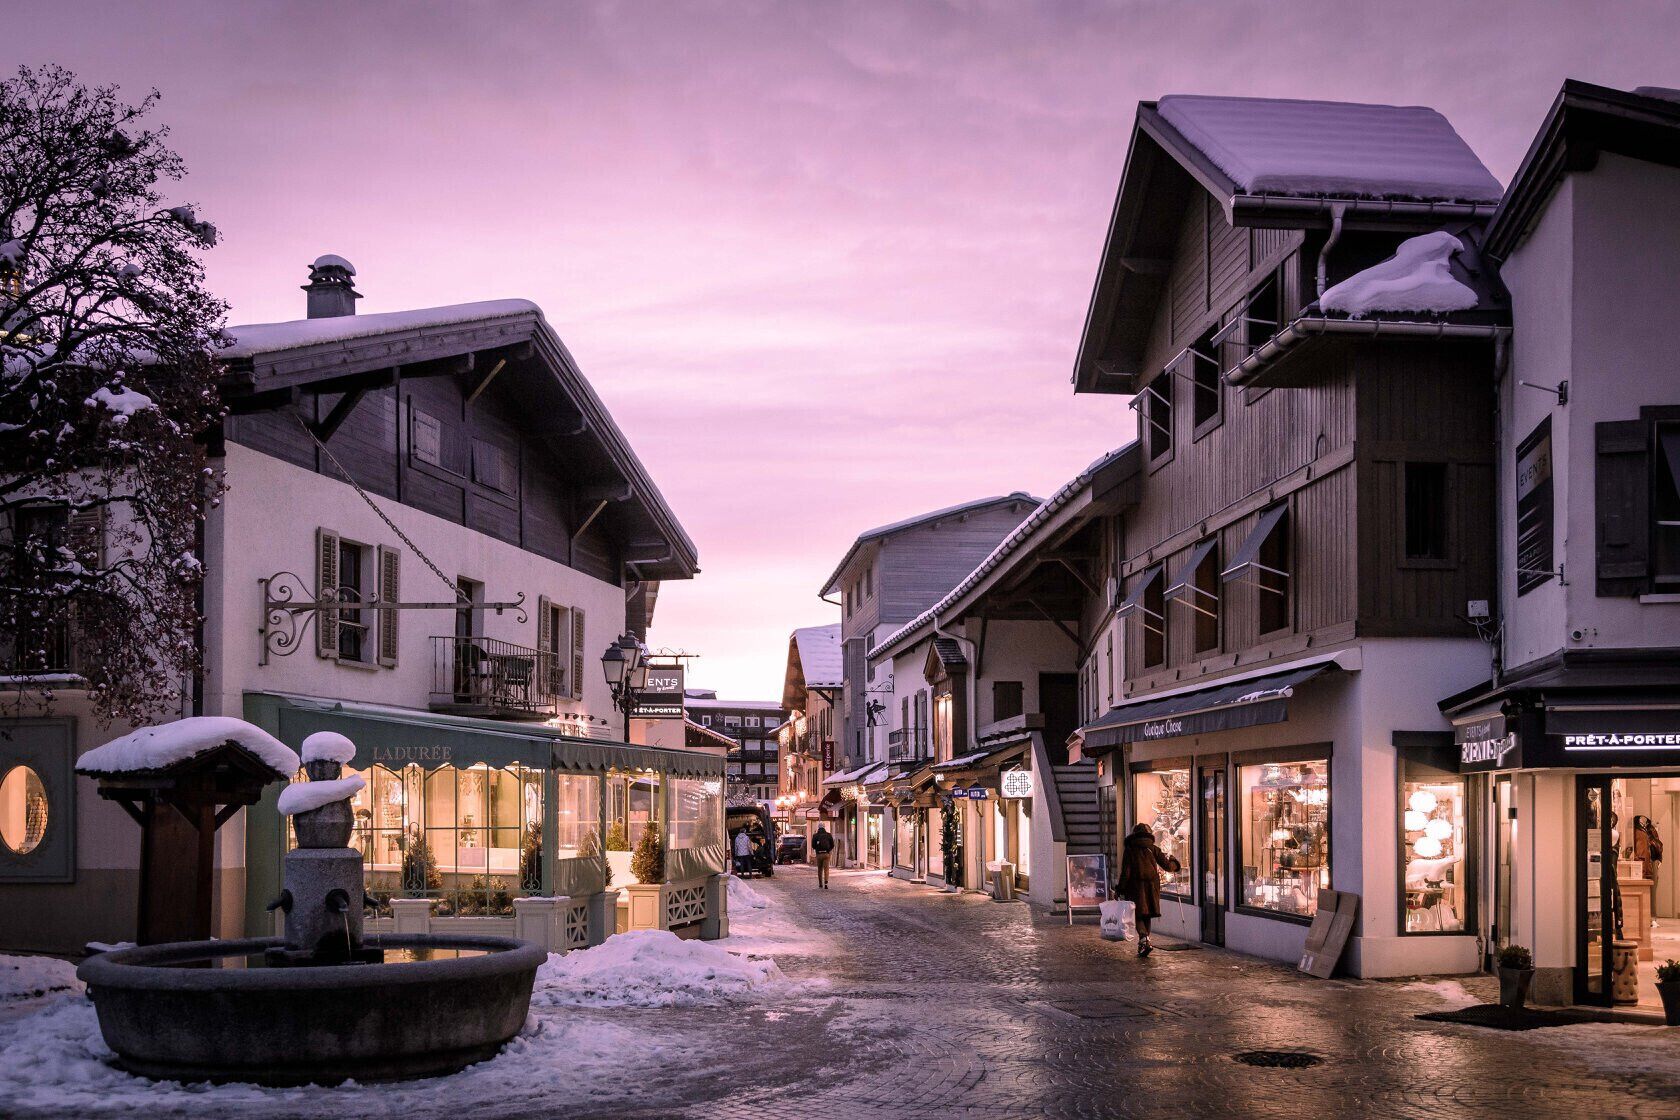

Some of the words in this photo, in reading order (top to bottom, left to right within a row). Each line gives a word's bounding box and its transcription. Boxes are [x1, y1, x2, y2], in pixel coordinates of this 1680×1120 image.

[1520, 453, 1547, 487] EVENTS
[647, 678, 678, 686] ENTS
[372, 745, 452, 760] LADURÉE
